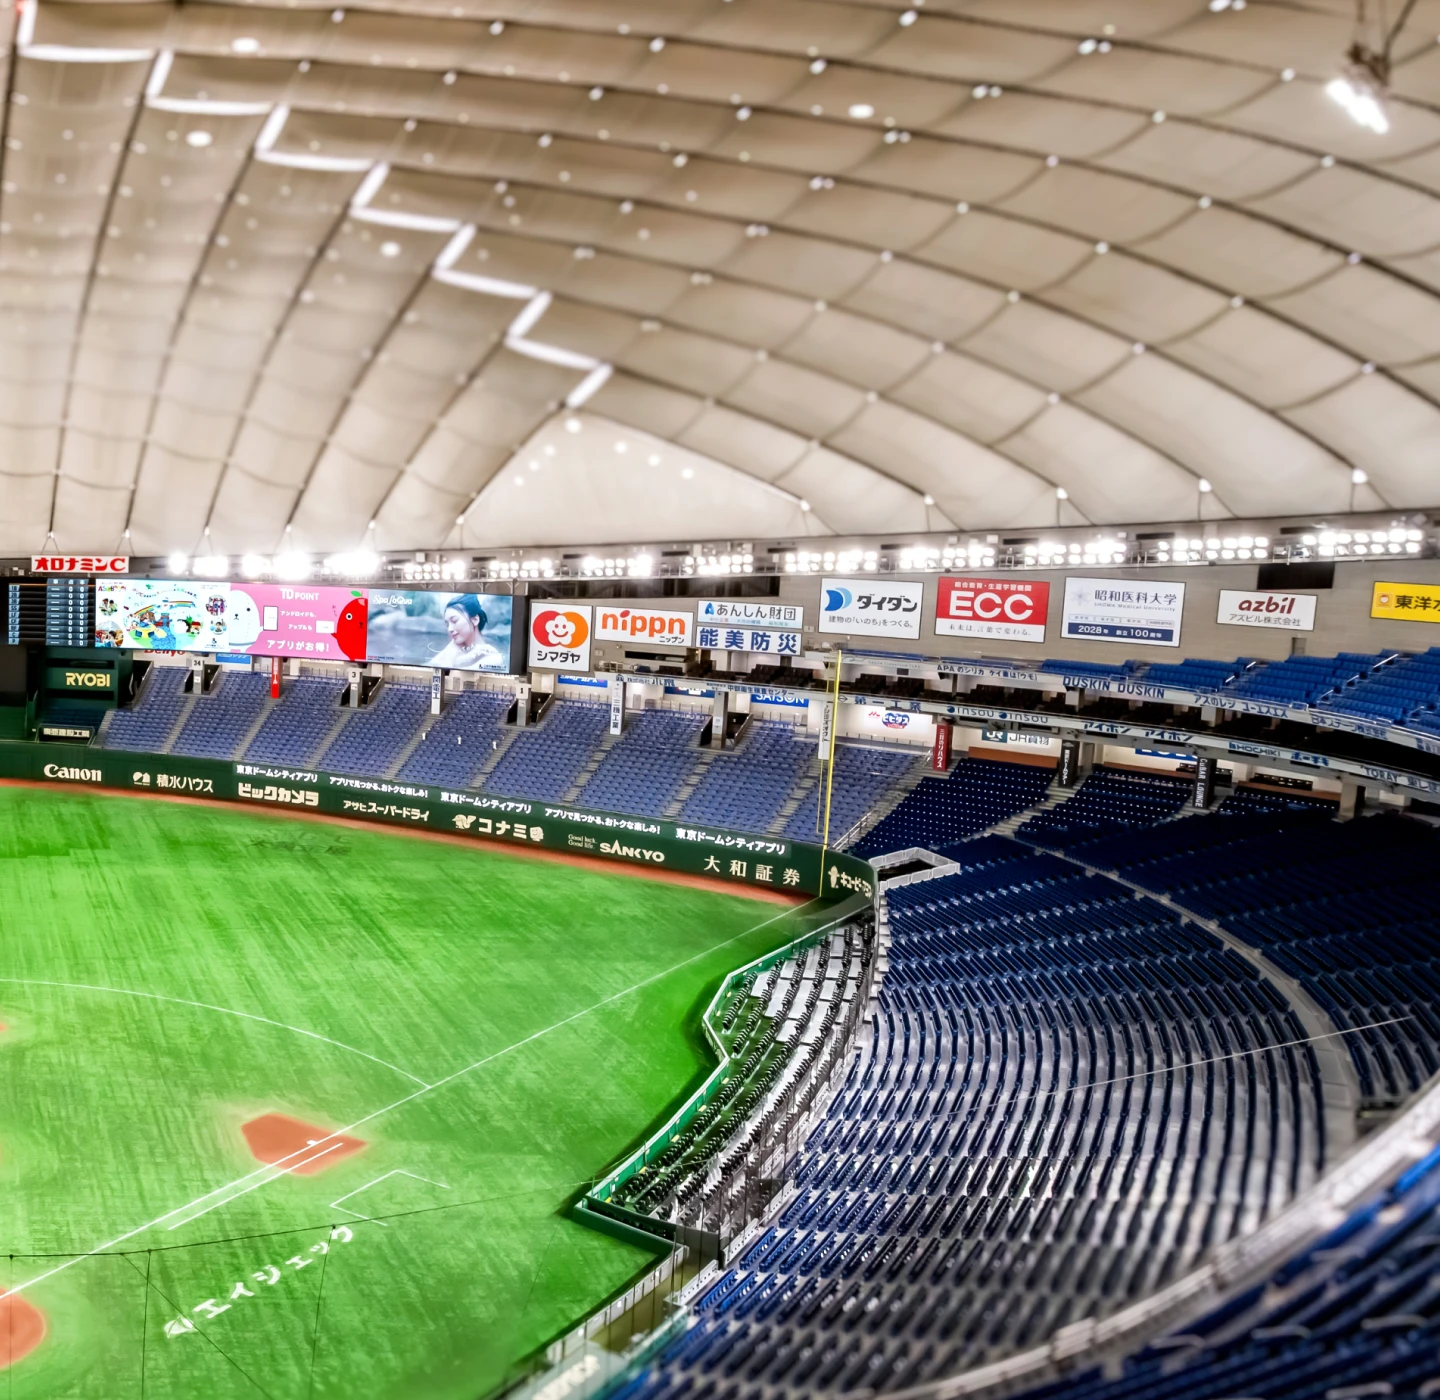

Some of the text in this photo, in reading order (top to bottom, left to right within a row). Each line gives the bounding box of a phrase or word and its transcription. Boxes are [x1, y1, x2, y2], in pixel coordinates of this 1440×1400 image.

[34, 557, 126, 572] オロナミンC
[857, 594, 918, 612] ダイダン
[949, 590, 1033, 620] ECC
[1094, 590, 1177, 605] 昭和医科大学
[1238, 595, 1296, 615] azbil
[717, 604, 796, 621] あんしん財団
[1229, 613, 1301, 627] アズビル株式会社
[601, 610, 686, 637] nippn
[659, 636, 685, 644] ニップン
[700, 628, 797, 654] 能美防災
[537, 650, 581, 664] シマダヤ
[66, 673, 110, 687] RYOBI
[1063, 676, 1165, 699] DUSKIN DUSKIN
[43, 763, 102, 782] Canon
[236, 765, 318, 783] 東京ドームシティアプリ
[156, 773, 214, 793] 積水ハウス
[238, 782, 319, 807] ビックカメラ
[441, 791, 532, 814] 東京ドームシティアプリ
[1194, 782, 1206, 808] LOUNGE
[479, 818, 527, 839] コナミ
[599, 840, 665, 862] SANKYO
[676, 827, 786, 855] 東京ドームシティアプリ
[704, 855, 801, 886] 大和証券
[192, 1226, 354, 1319] エイジェック
